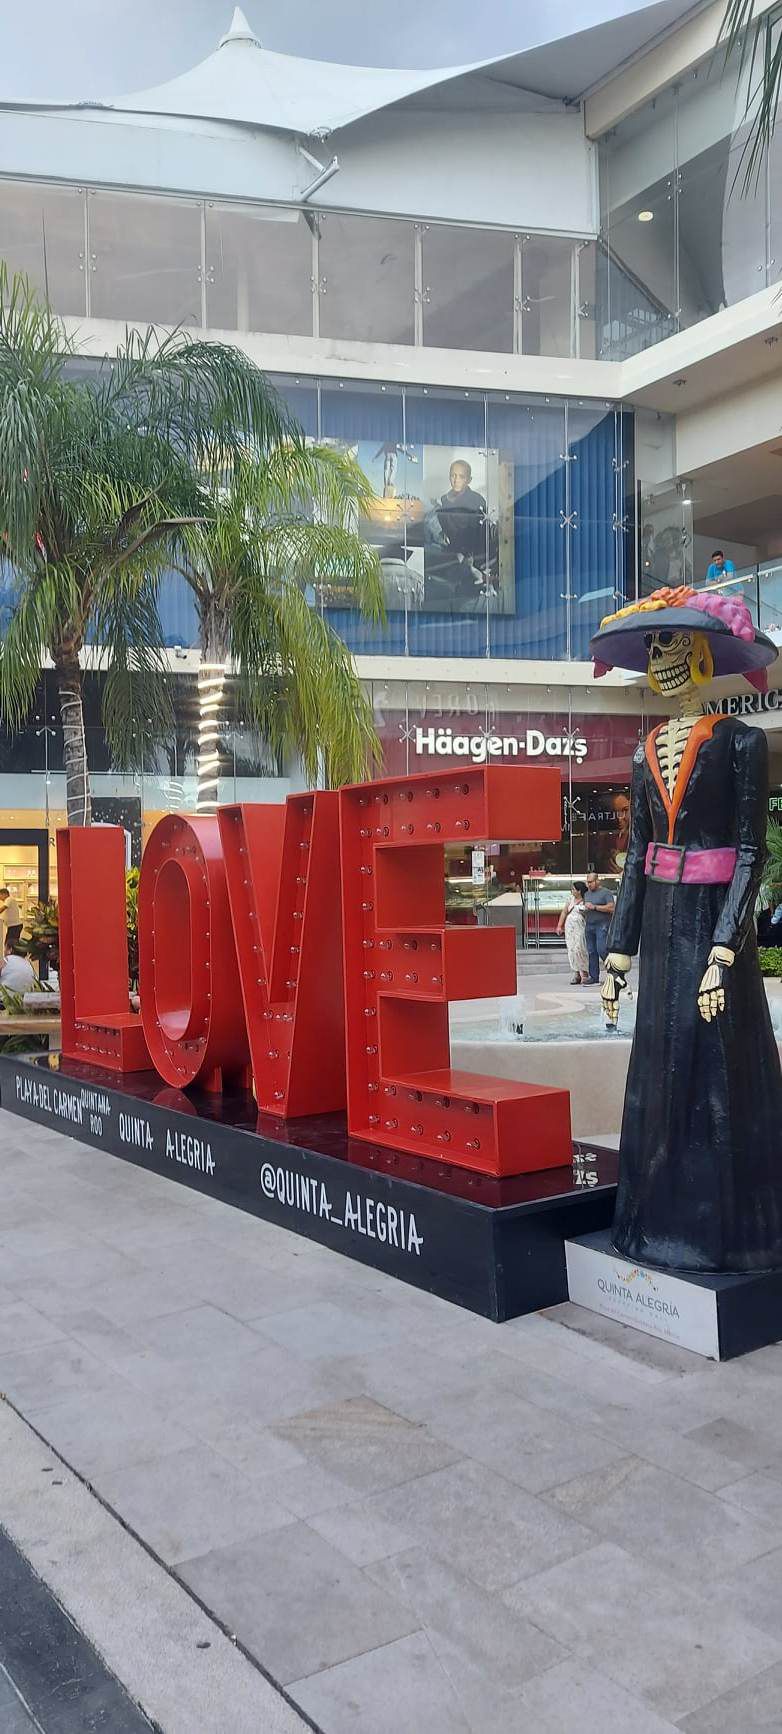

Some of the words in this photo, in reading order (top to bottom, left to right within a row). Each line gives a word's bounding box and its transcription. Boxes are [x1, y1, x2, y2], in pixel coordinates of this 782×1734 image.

[701, 689, 782, 716] MERIC
[415, 727, 588, 764] Häagen-Dazs
[56, 765, 571, 1177] LOVE
[15, 1076, 39, 1106] PLAYA
[39, 1084, 52, 1113] DEL
[53, 1090, 83, 1125] CARMEN
[81, 1088, 111, 1117] QUINTANA
[90, 1114, 103, 1137] ROO
[119, 1112, 154, 1151] QUINTA
[166, 1128, 216, 1176] ALEGRIA
[260, 1163, 424, 1256] @QUINTA_ALEGRIA
[597, 1278, 633, 1303] QUINTA
